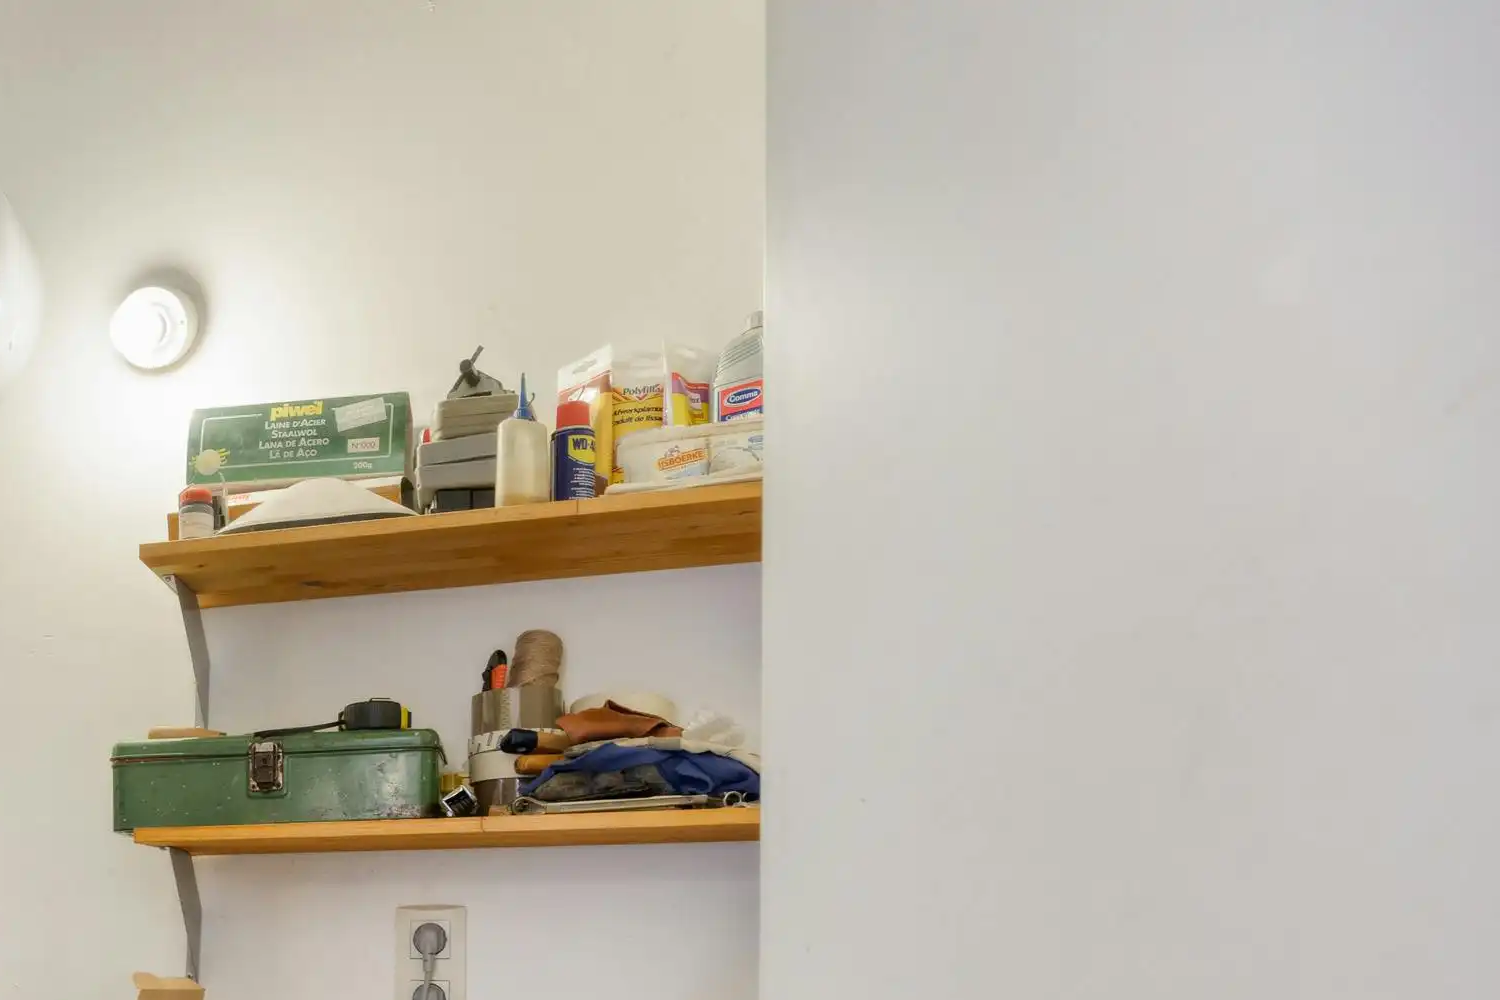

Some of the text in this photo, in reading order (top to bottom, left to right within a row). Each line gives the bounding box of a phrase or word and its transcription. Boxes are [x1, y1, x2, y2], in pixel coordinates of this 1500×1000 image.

[729, 389, 759, 403] Comma
[264, 420, 290, 430] LAINE
[271, 429, 318, 439] STAALWOL
[259, 437, 330, 450] LANA DE ACERO
[283, 450, 294, 459] DE
